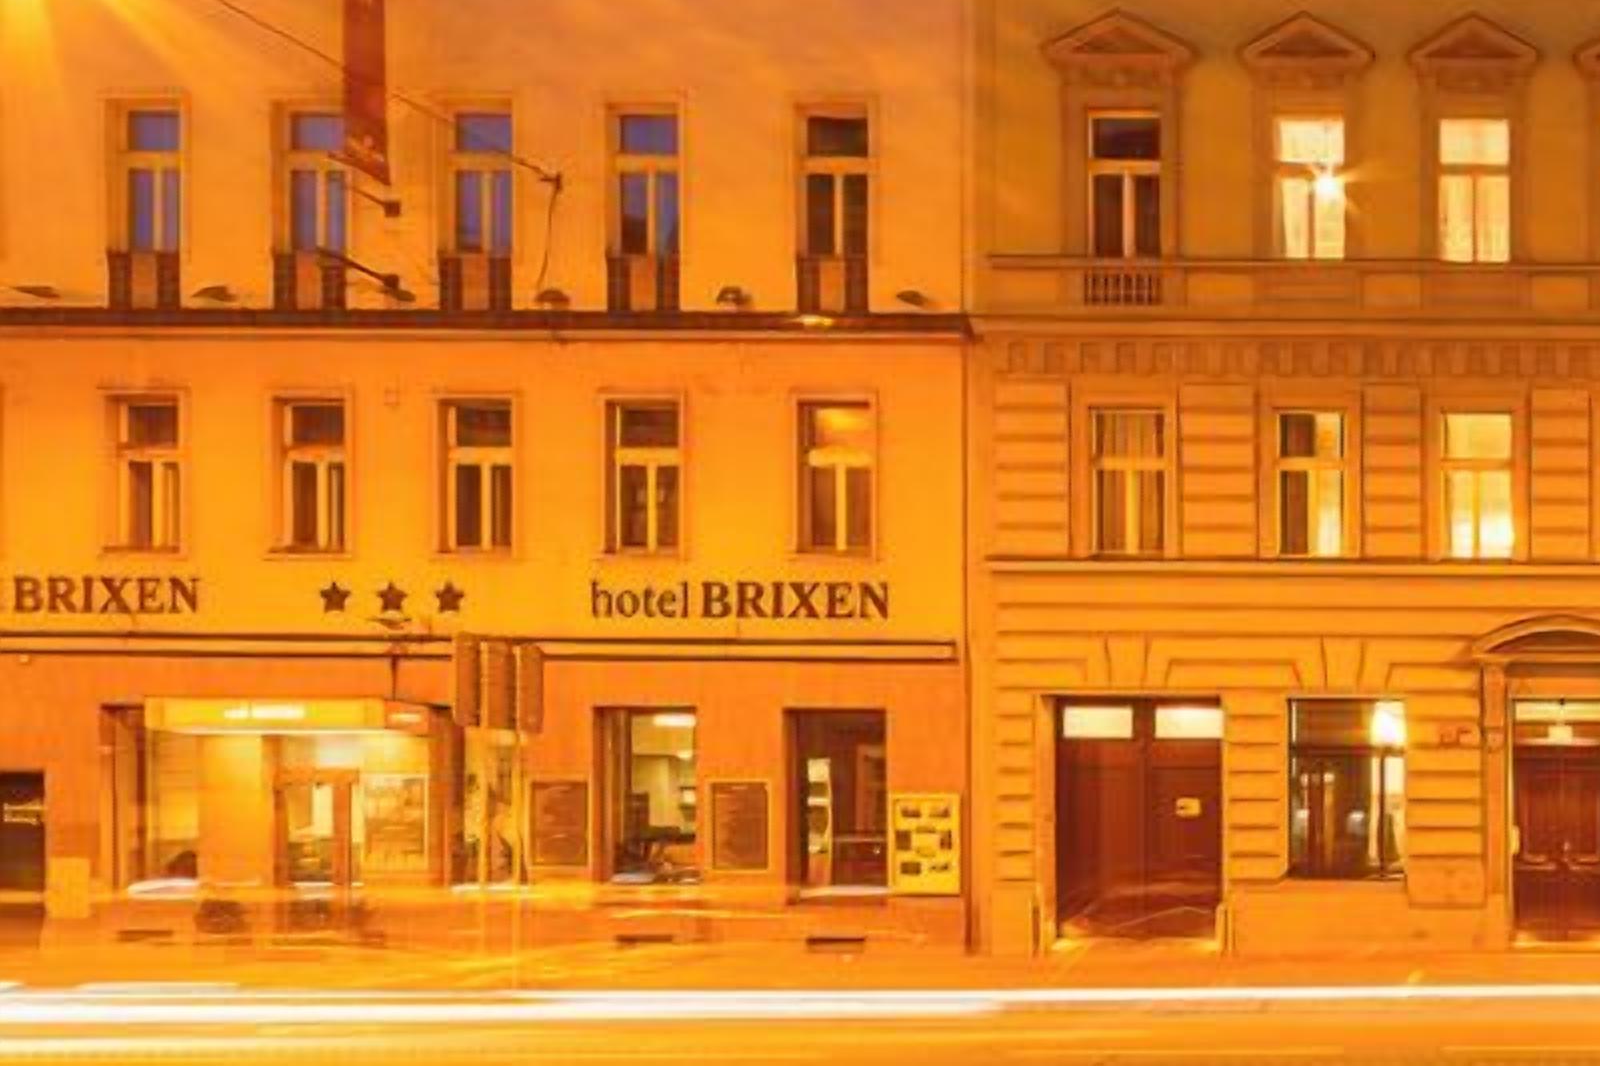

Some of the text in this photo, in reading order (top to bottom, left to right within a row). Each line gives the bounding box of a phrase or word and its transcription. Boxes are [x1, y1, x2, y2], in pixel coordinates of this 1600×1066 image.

[13, 575, 200, 614] BRIXEN
[591, 580, 889, 620] hotel BRIXEN
